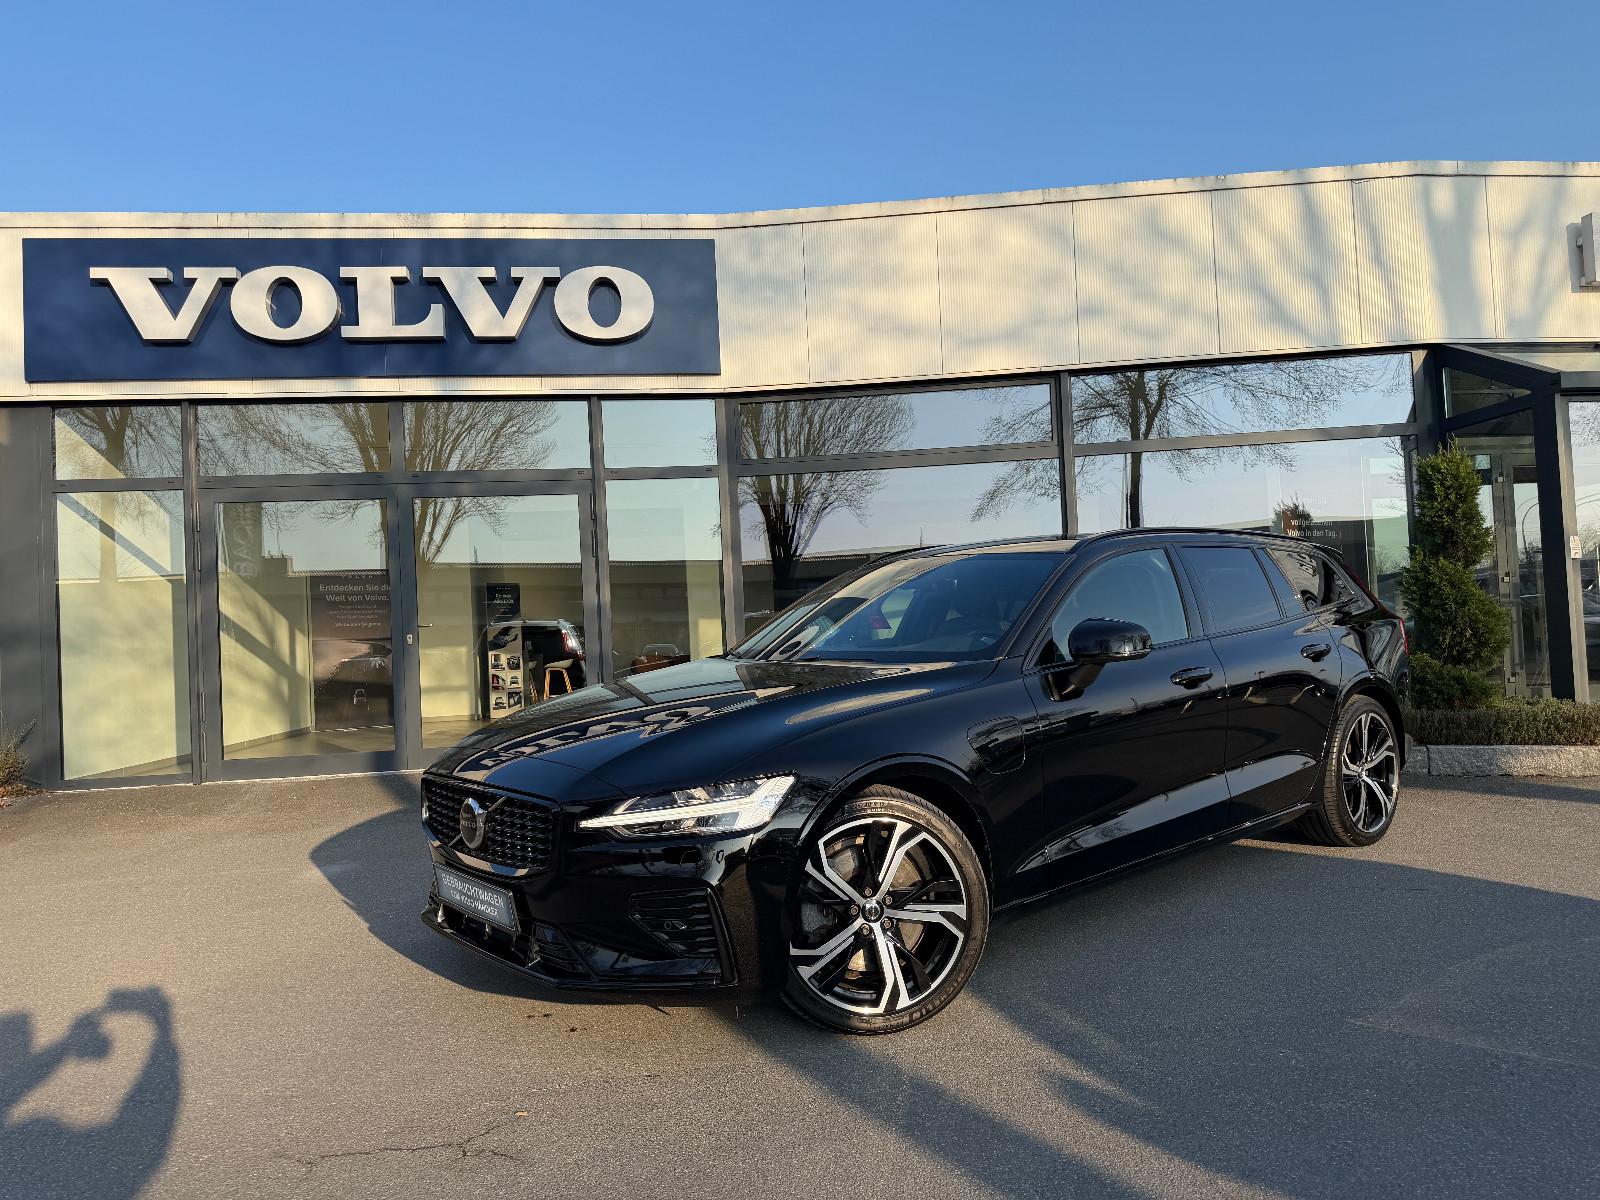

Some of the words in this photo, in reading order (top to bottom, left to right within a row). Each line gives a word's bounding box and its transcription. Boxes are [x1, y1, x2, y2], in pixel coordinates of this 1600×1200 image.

[89, 265, 655, 345] VOLVO
[319, 583, 364, 591] Entdecken
[365, 583, 381, 591] Sie
[325, 594, 346, 602] Welt
[347, 594, 363, 602] von
[364, 593, 390, 601] Volvo.
